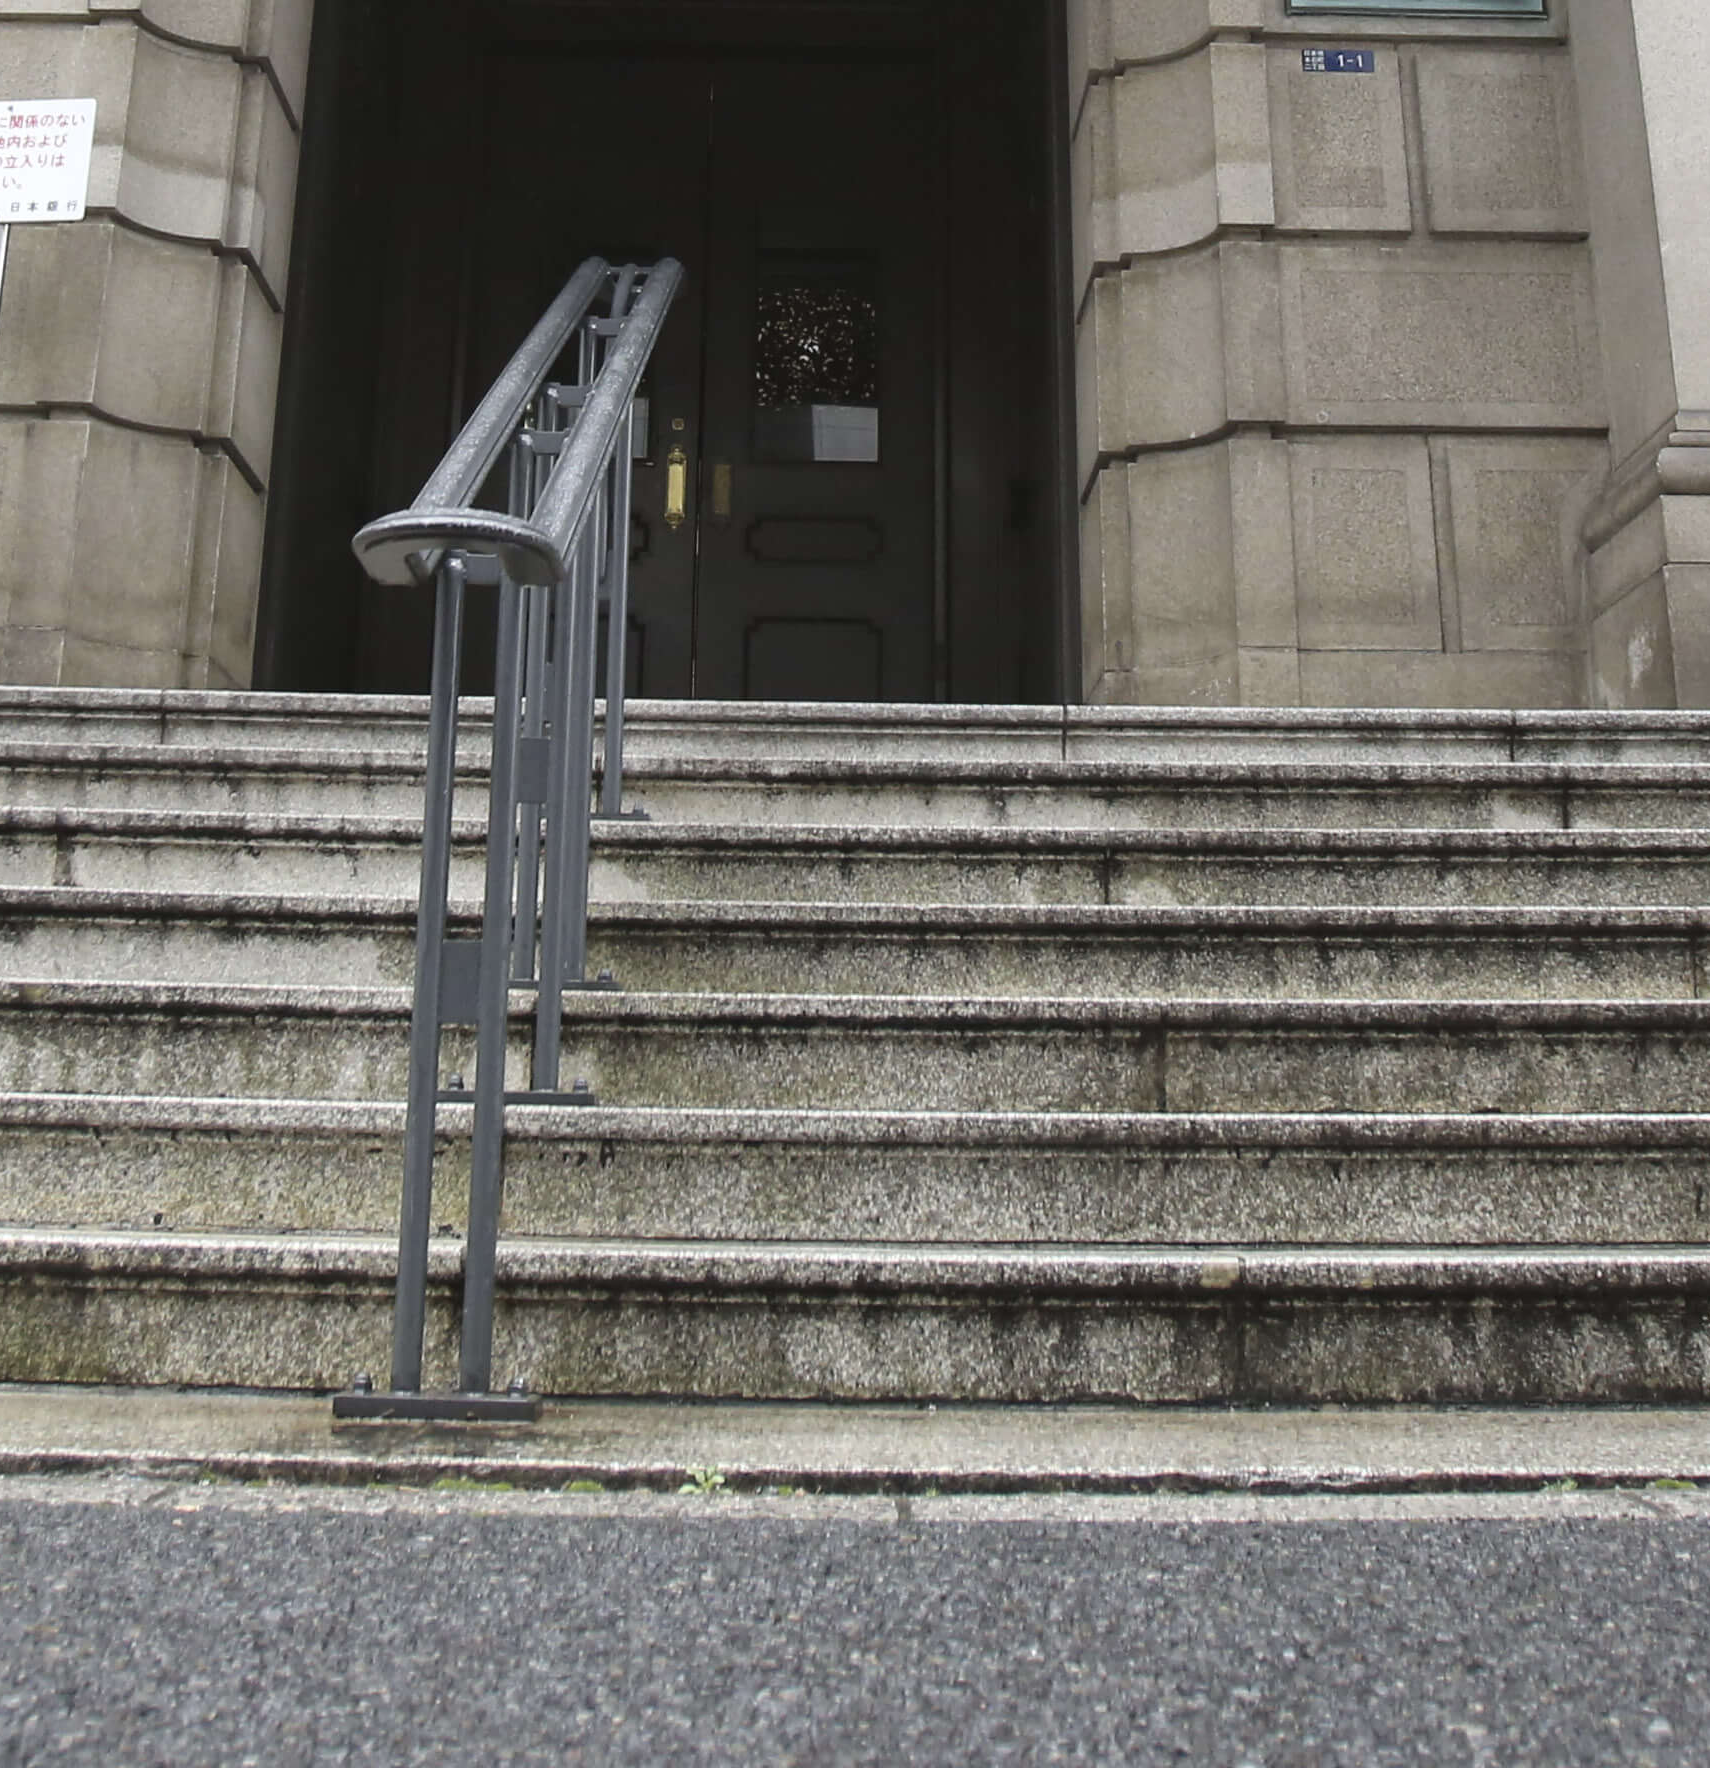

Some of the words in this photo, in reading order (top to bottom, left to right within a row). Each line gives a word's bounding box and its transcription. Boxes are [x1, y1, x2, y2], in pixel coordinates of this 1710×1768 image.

[1338, 54, 1363, 68] 1-1
[10, 200, 79, 213] 日本銀行
